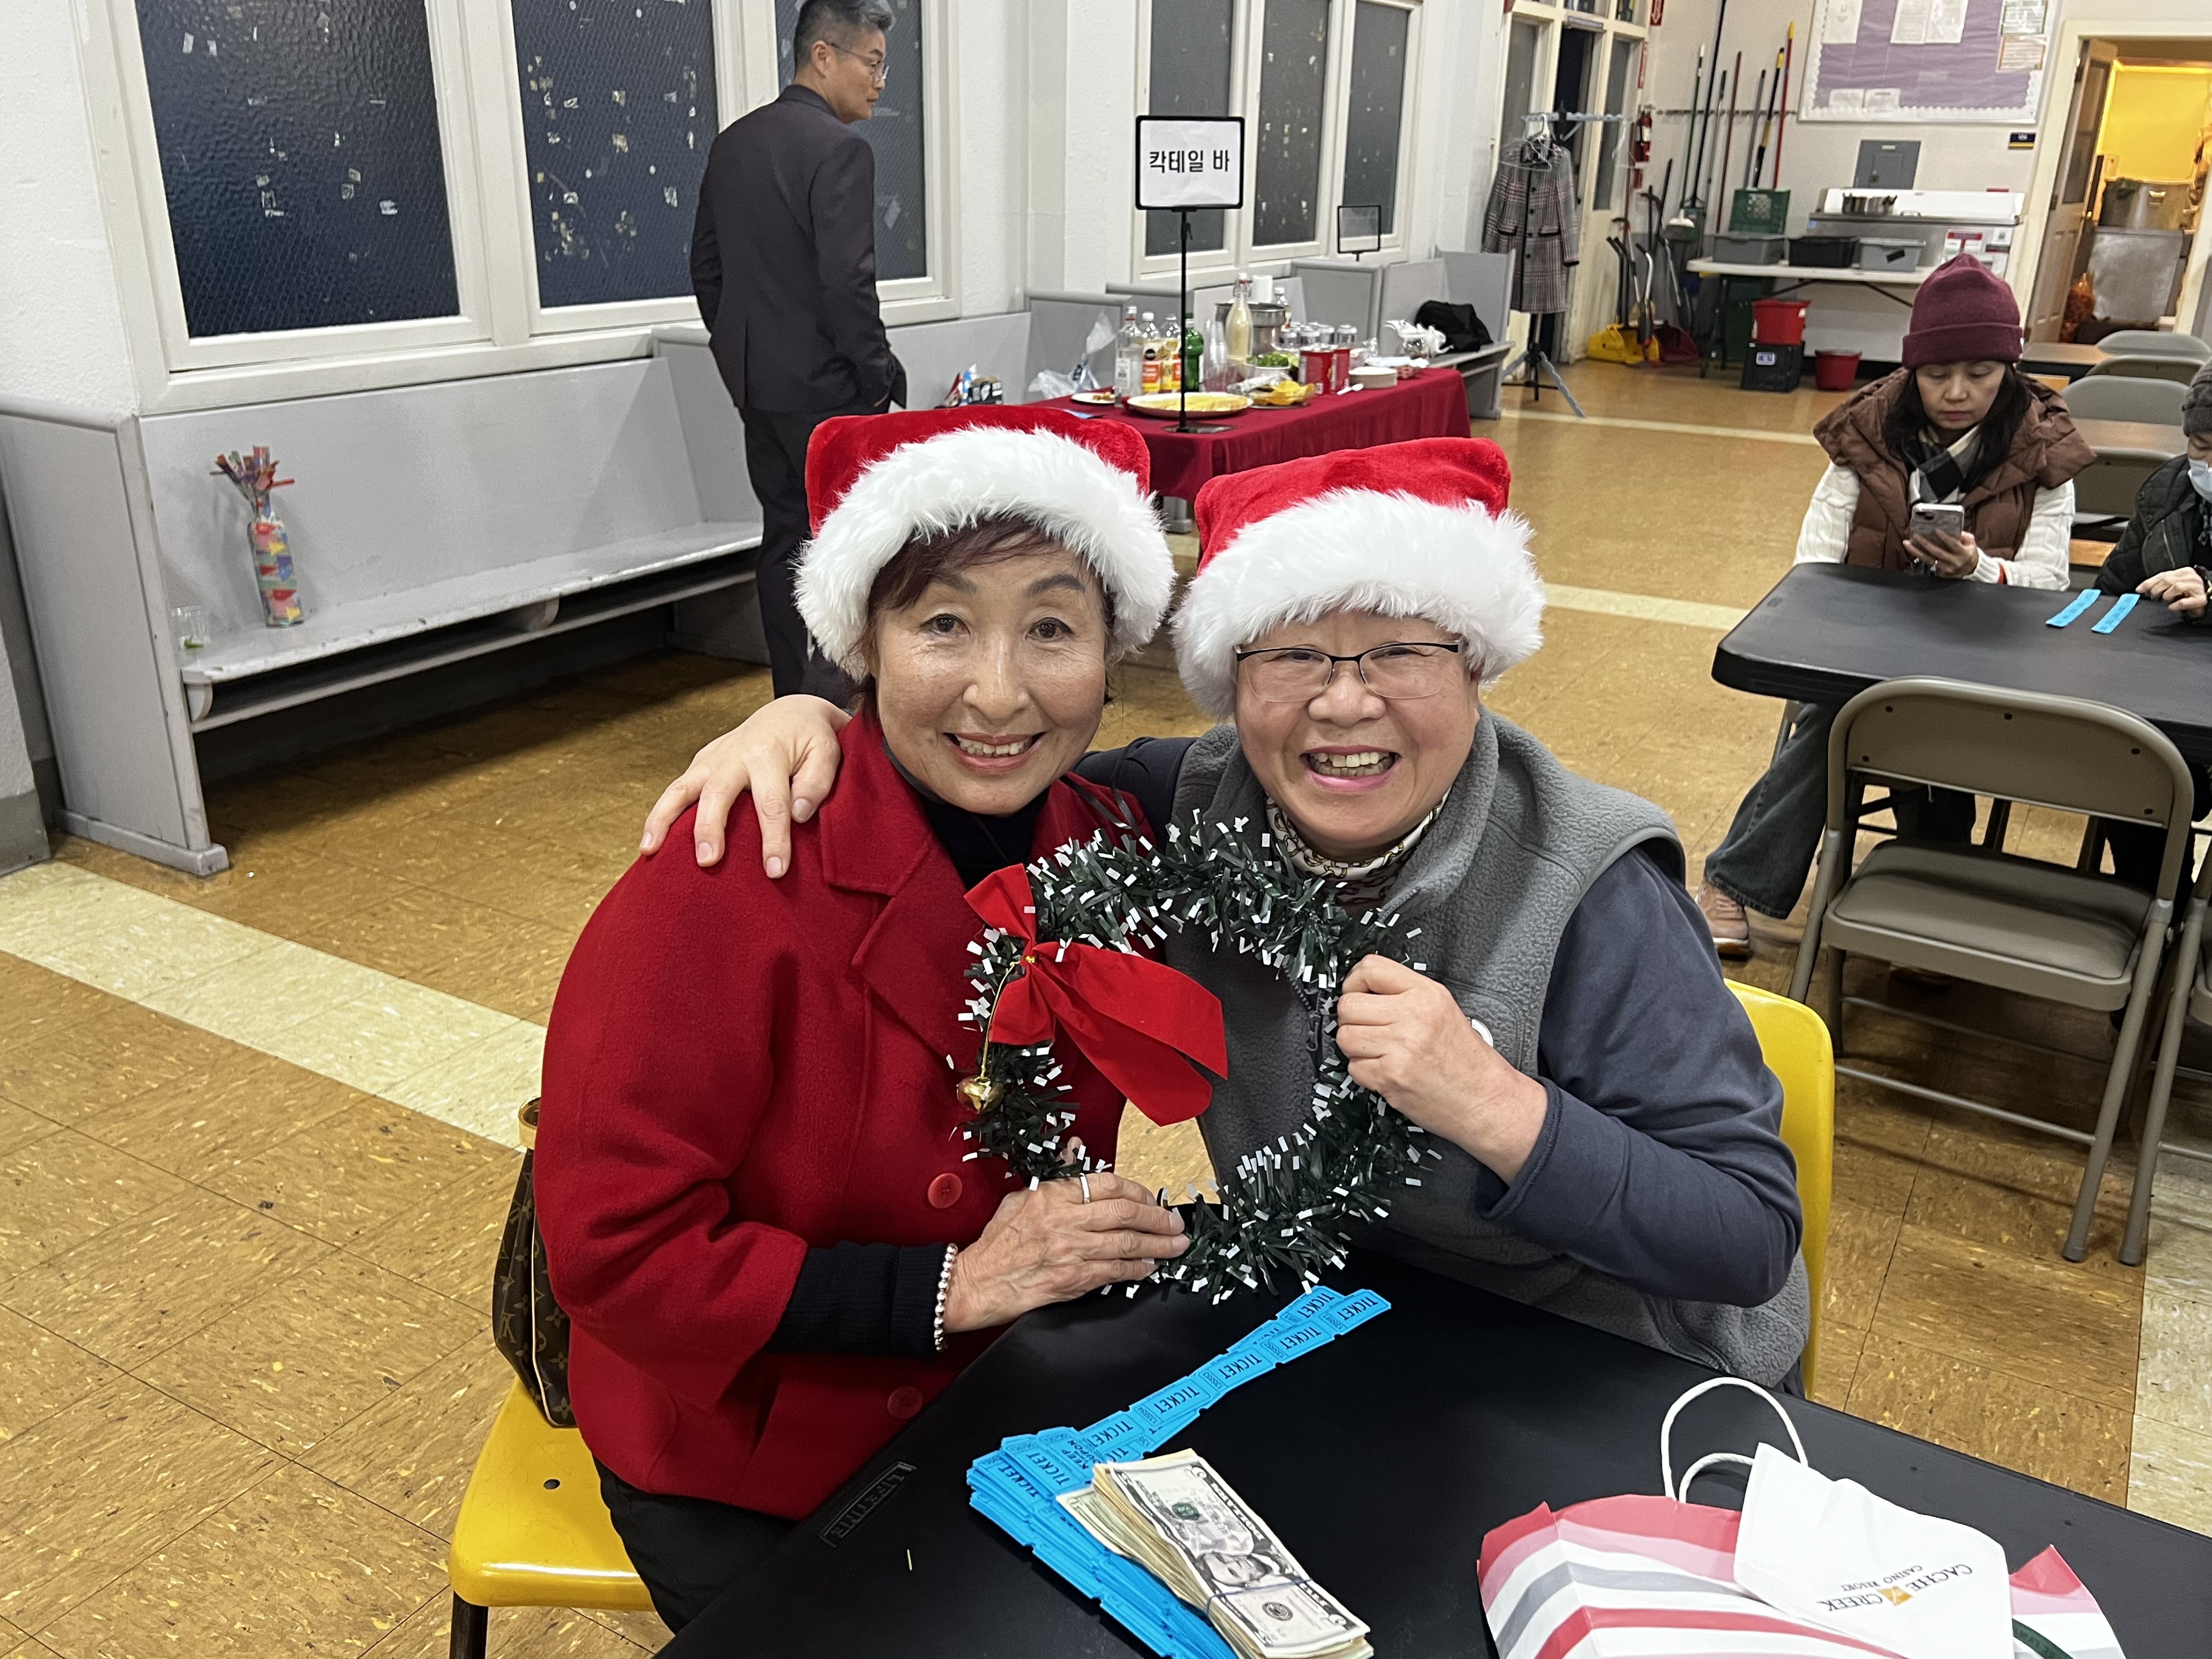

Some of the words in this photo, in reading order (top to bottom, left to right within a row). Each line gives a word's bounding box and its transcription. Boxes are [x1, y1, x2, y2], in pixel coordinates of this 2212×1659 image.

[1149, 150, 1204, 173] 칵테일
[1213, 149, 1230, 172] 바
[1297, 1293, 1335, 1318] TICKET
[1337, 1296, 1378, 1321] TICKET
[1279, 1327, 1322, 1350] TICKET
[1218, 1353, 1262, 1379] TICKET
[1154, 1386, 1200, 1414] TICKET
[1086, 1420, 1134, 1447] TICKET
[1061, 1449, 1089, 1470] KEEP
[1067, 1440, 1101, 1464] OUPON
[1106, 1447, 1129, 1463] TIC
[998, 1464, 1040, 1498] TICKET
[1026, 1452, 1070, 1486] TICKET
[830, 1474, 905, 1538] LIFETIME
[1840, 1580, 1881, 1592] RESORT
[1883, 1565, 1923, 1584] CASINO
[1905, 1564, 1973, 1592] CACHE
[1816, 1593, 1883, 1612] CREEK
